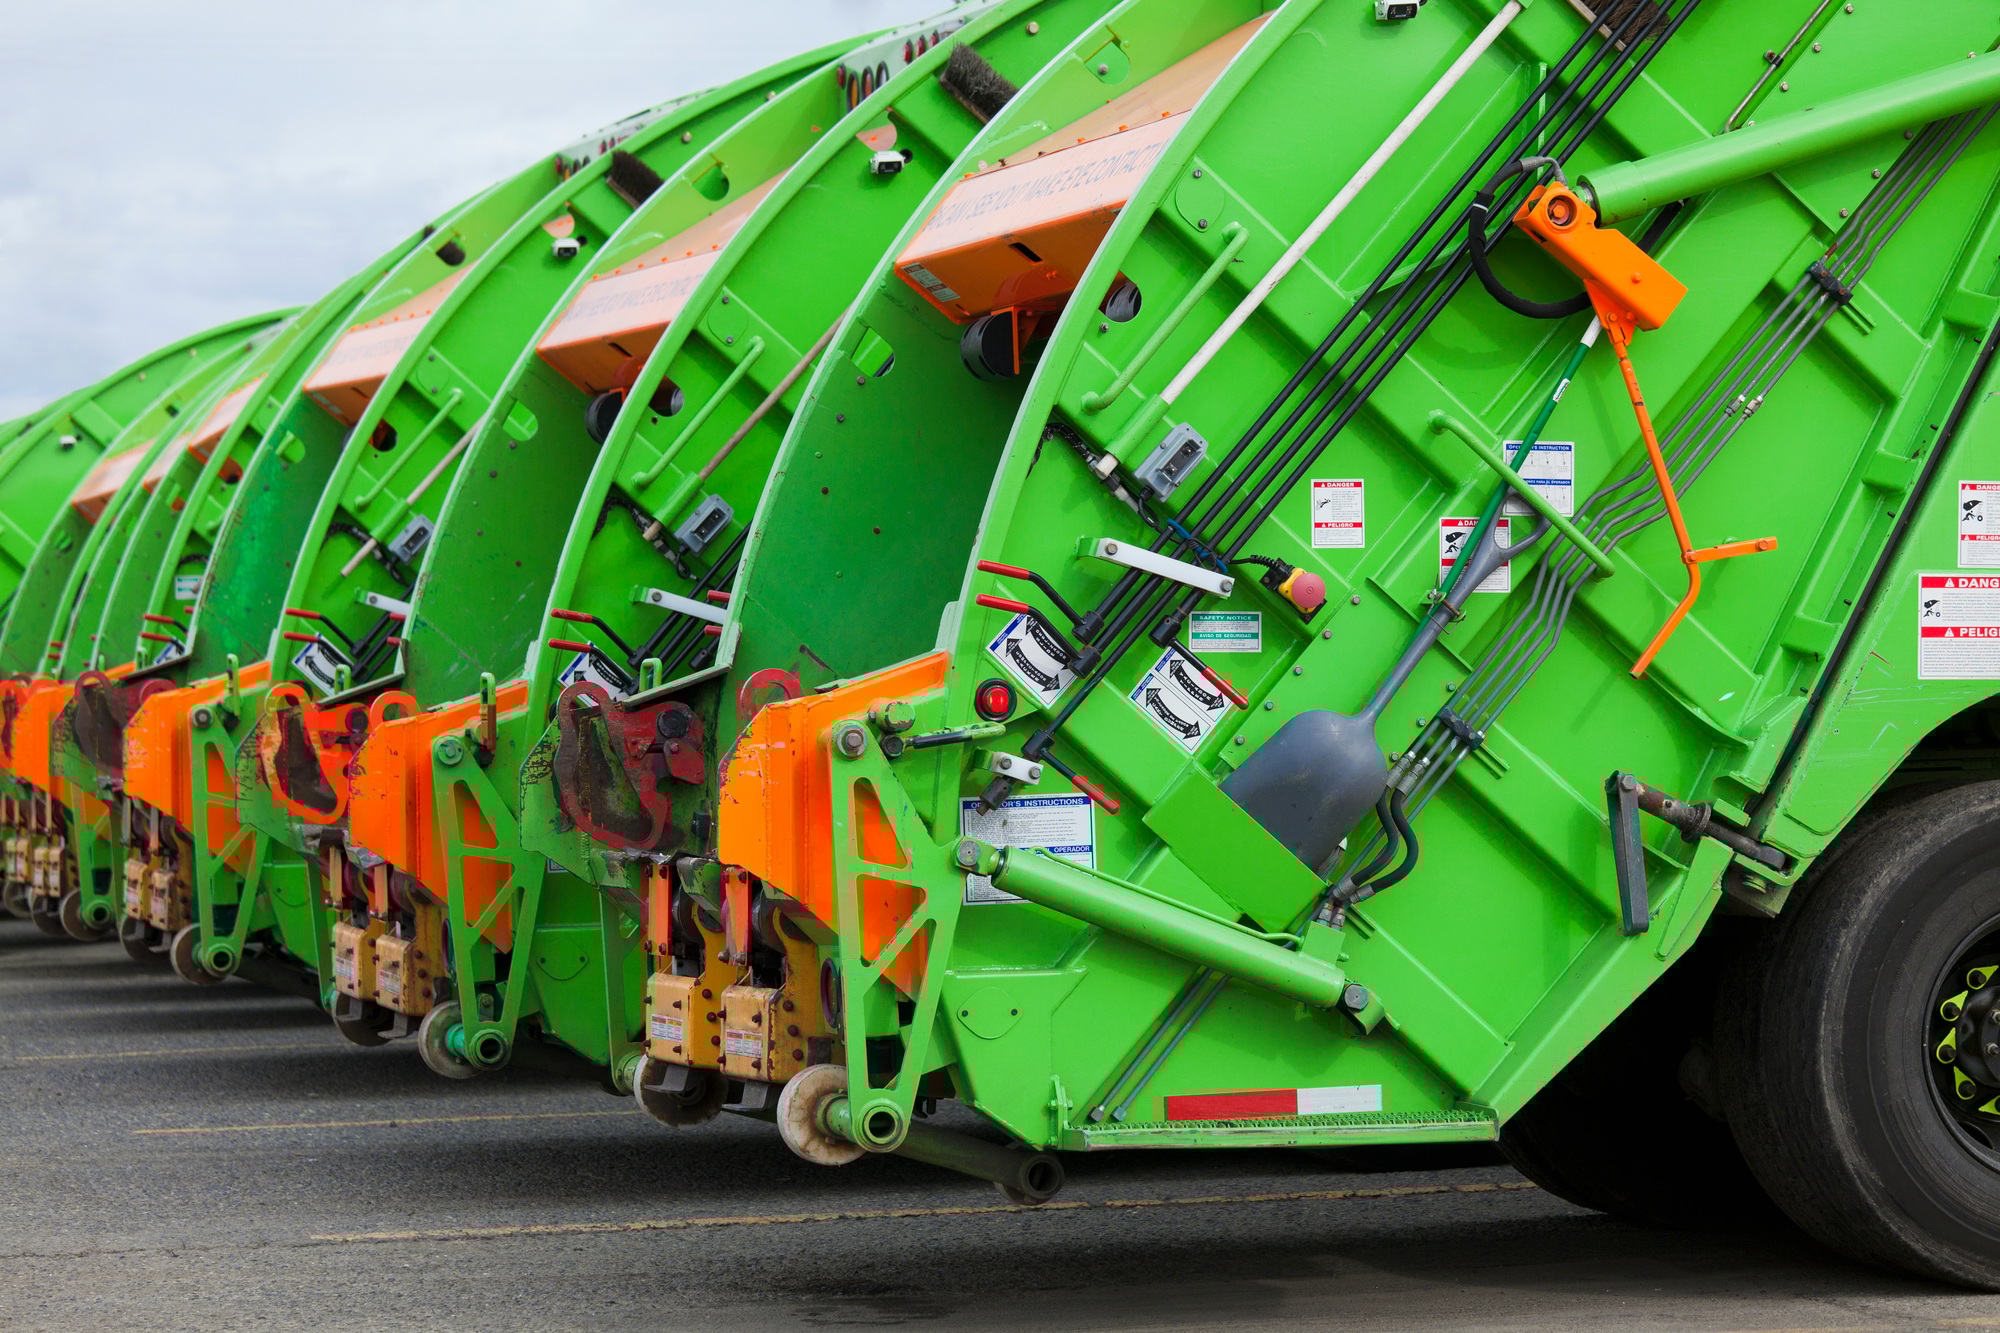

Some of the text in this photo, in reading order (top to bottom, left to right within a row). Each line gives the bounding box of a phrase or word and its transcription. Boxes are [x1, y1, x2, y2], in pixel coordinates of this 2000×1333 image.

[1021, 169, 1072, 202] MAKE
[1056, 162, 1098, 192] EYE
[1958, 578, 2000, 588] DANG
[1016, 658, 1040, 682] PACKER
[1179, 672, 1212, 701] VACIADOR
[1179, 680, 1204, 702] TIPPER
[1024, 798, 1084, 806] INSTRUCTIONS
